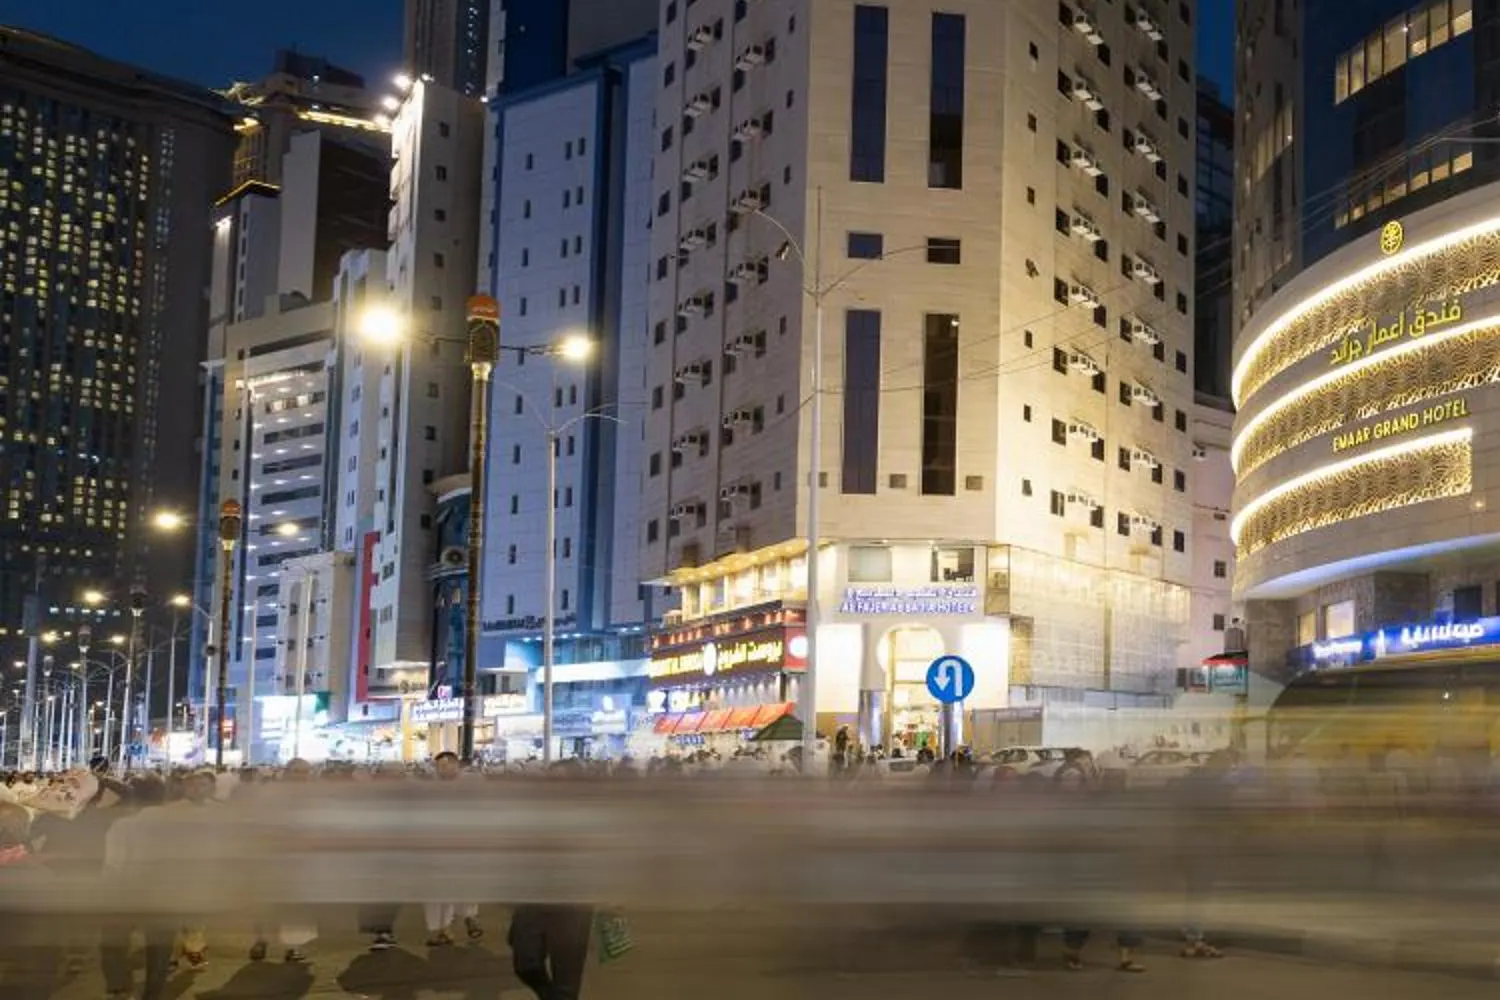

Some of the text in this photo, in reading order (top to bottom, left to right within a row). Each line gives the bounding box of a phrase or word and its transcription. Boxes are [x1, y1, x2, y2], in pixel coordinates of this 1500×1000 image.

[1408, 299, 1461, 338] فندق
[1333, 399, 1468, 452] EMAAR GRAND HOTEL
